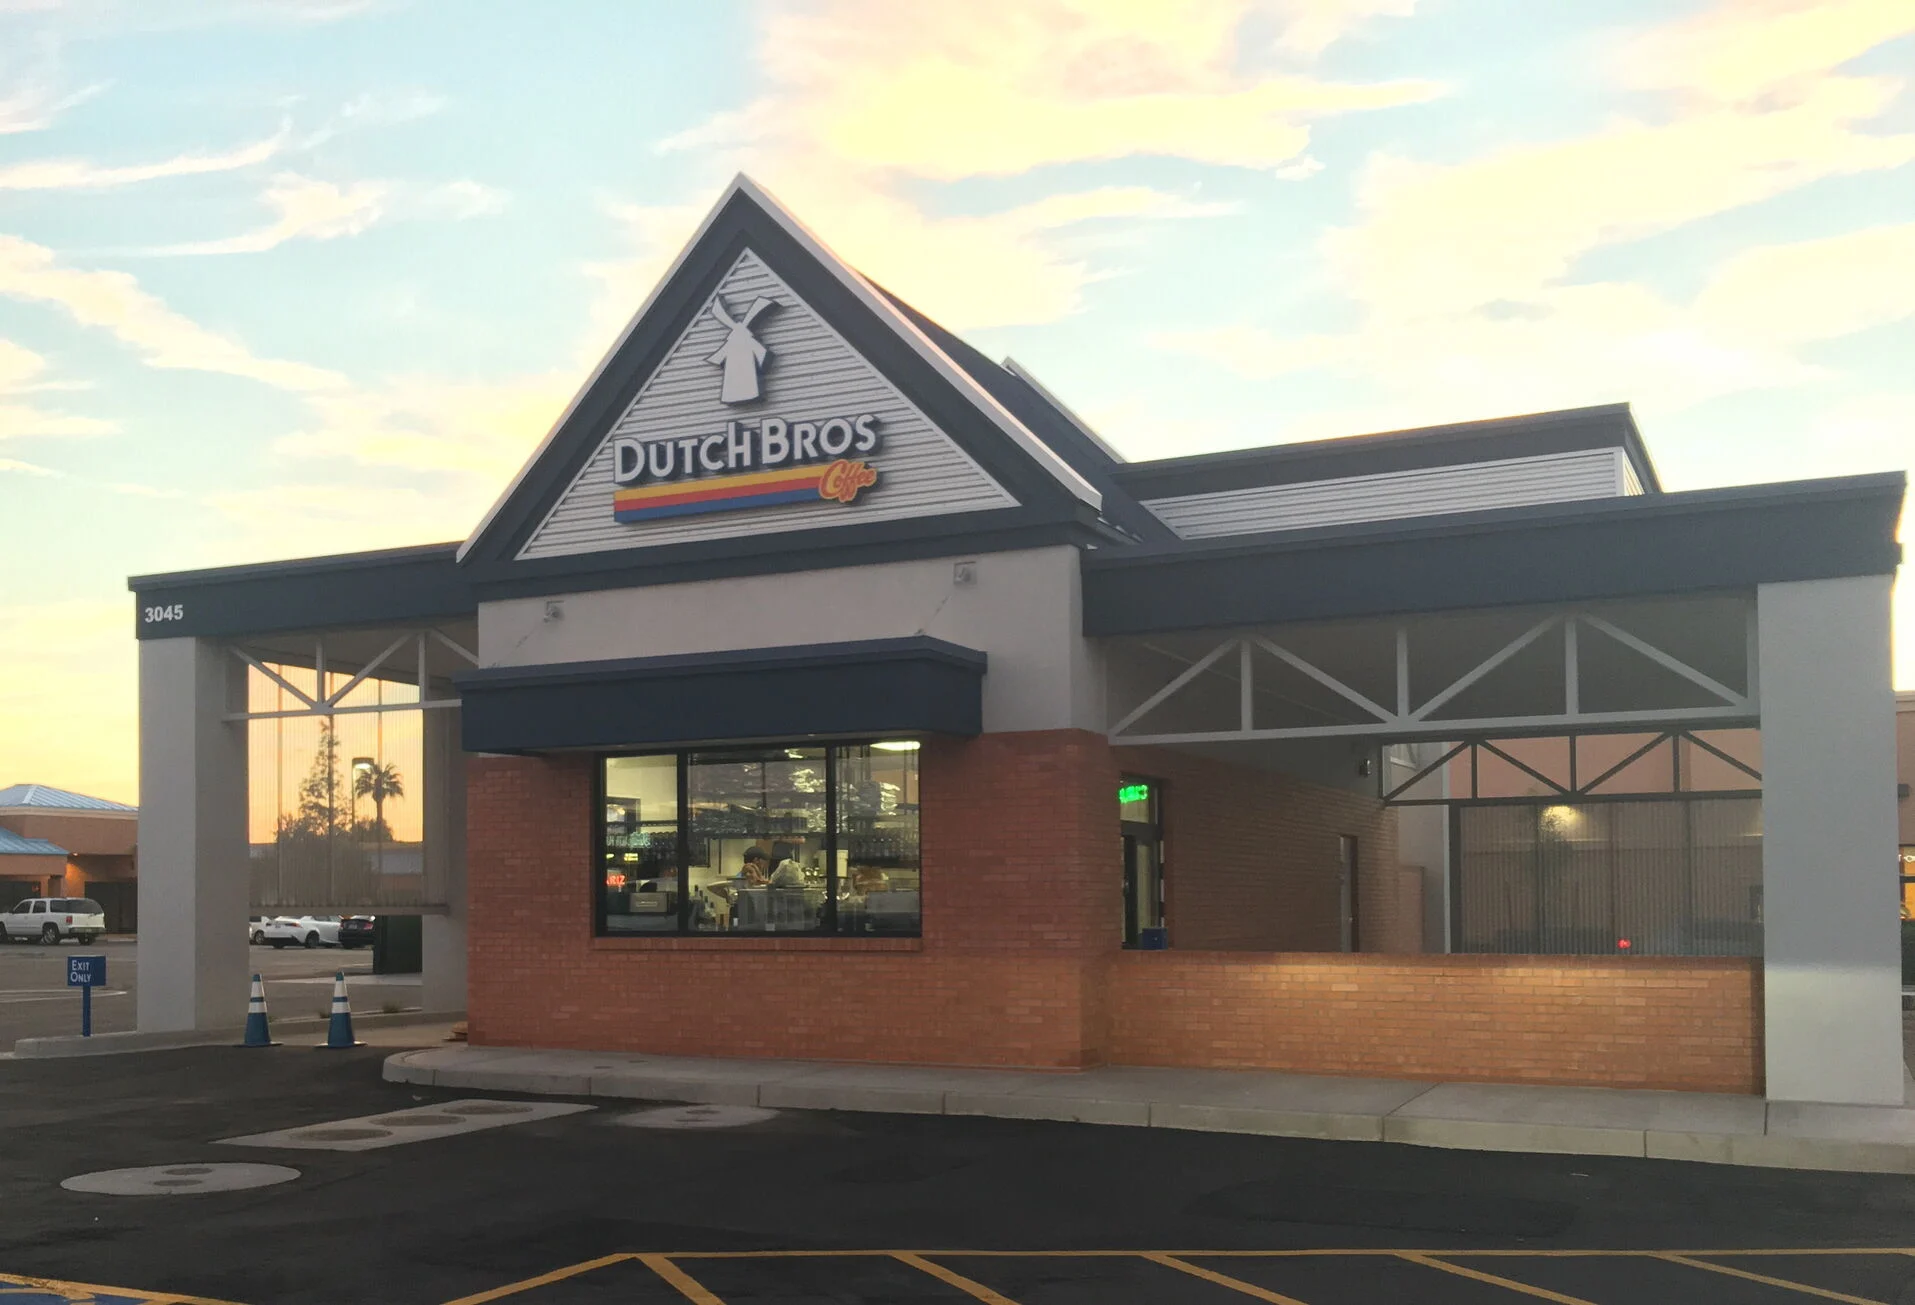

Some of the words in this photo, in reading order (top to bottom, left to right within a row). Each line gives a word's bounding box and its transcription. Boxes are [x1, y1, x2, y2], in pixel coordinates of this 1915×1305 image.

[614, 421, 751, 484] DUTCH
[761, 414, 877, 465] BROS
[820, 459, 877, 502] Coffee
[144, 604, 184, 623] 3045
[71, 959, 90, 971] EXIT
[70, 971, 91, 983] ONLY
